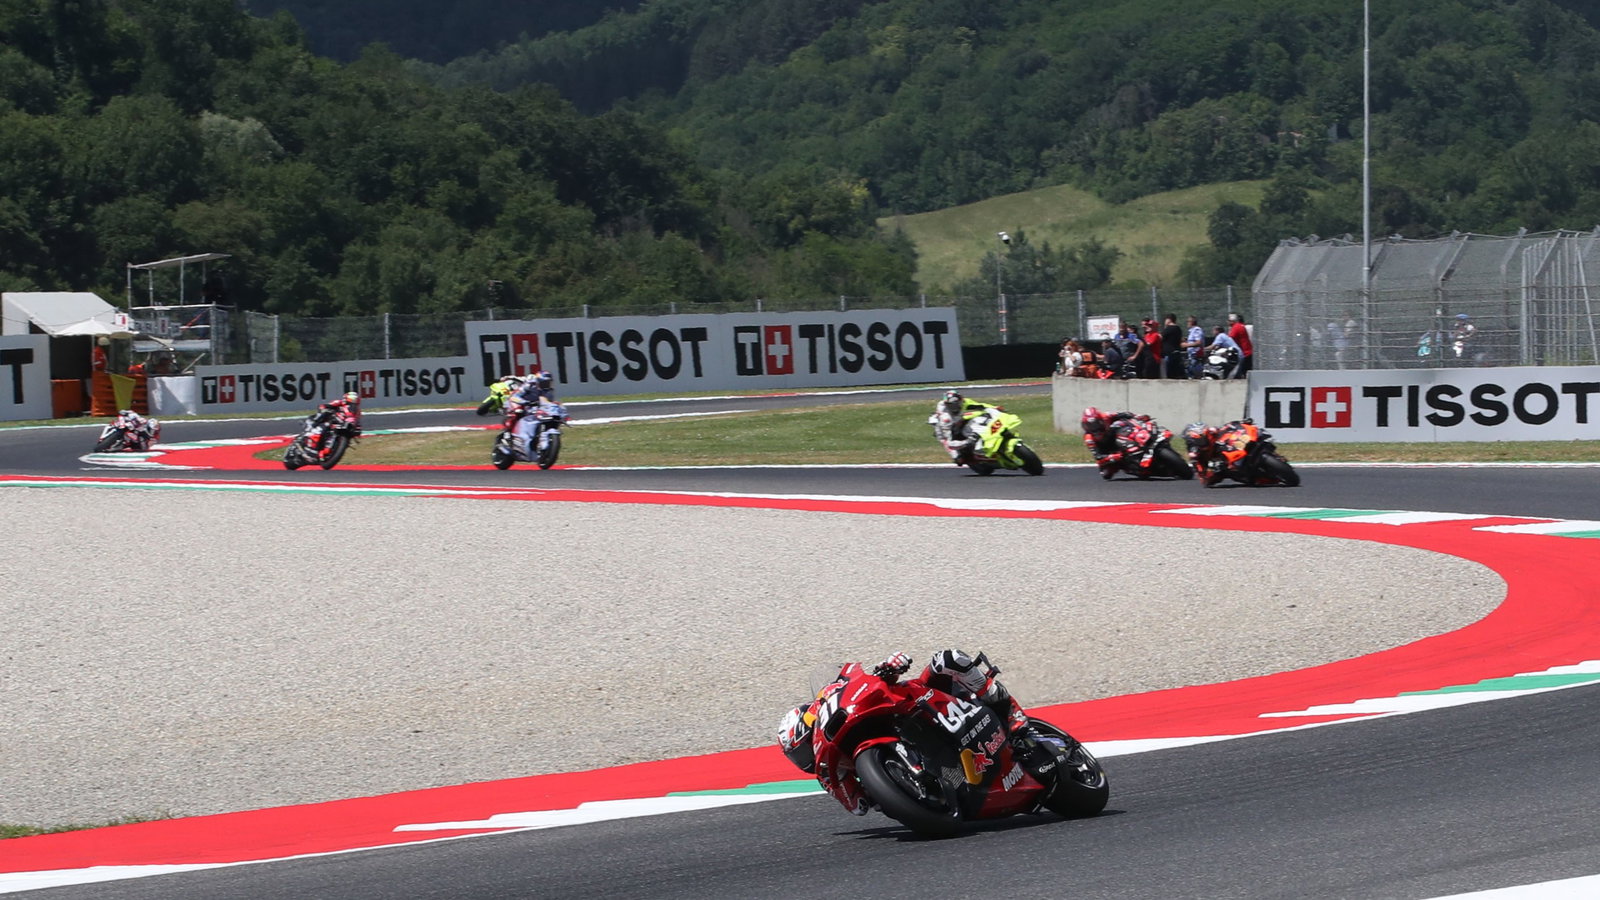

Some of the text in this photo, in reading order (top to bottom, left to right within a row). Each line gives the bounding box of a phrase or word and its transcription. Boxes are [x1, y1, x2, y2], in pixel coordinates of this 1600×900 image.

[545, 327, 707, 385] TISSOT
[735, 321, 948, 375] T TISSOT
[0, 348, 34, 405] T
[239, 373, 331, 403] TISSOT
[379, 367, 465, 398] TISSOT
[1267, 382, 1600, 428] T TISSOT
